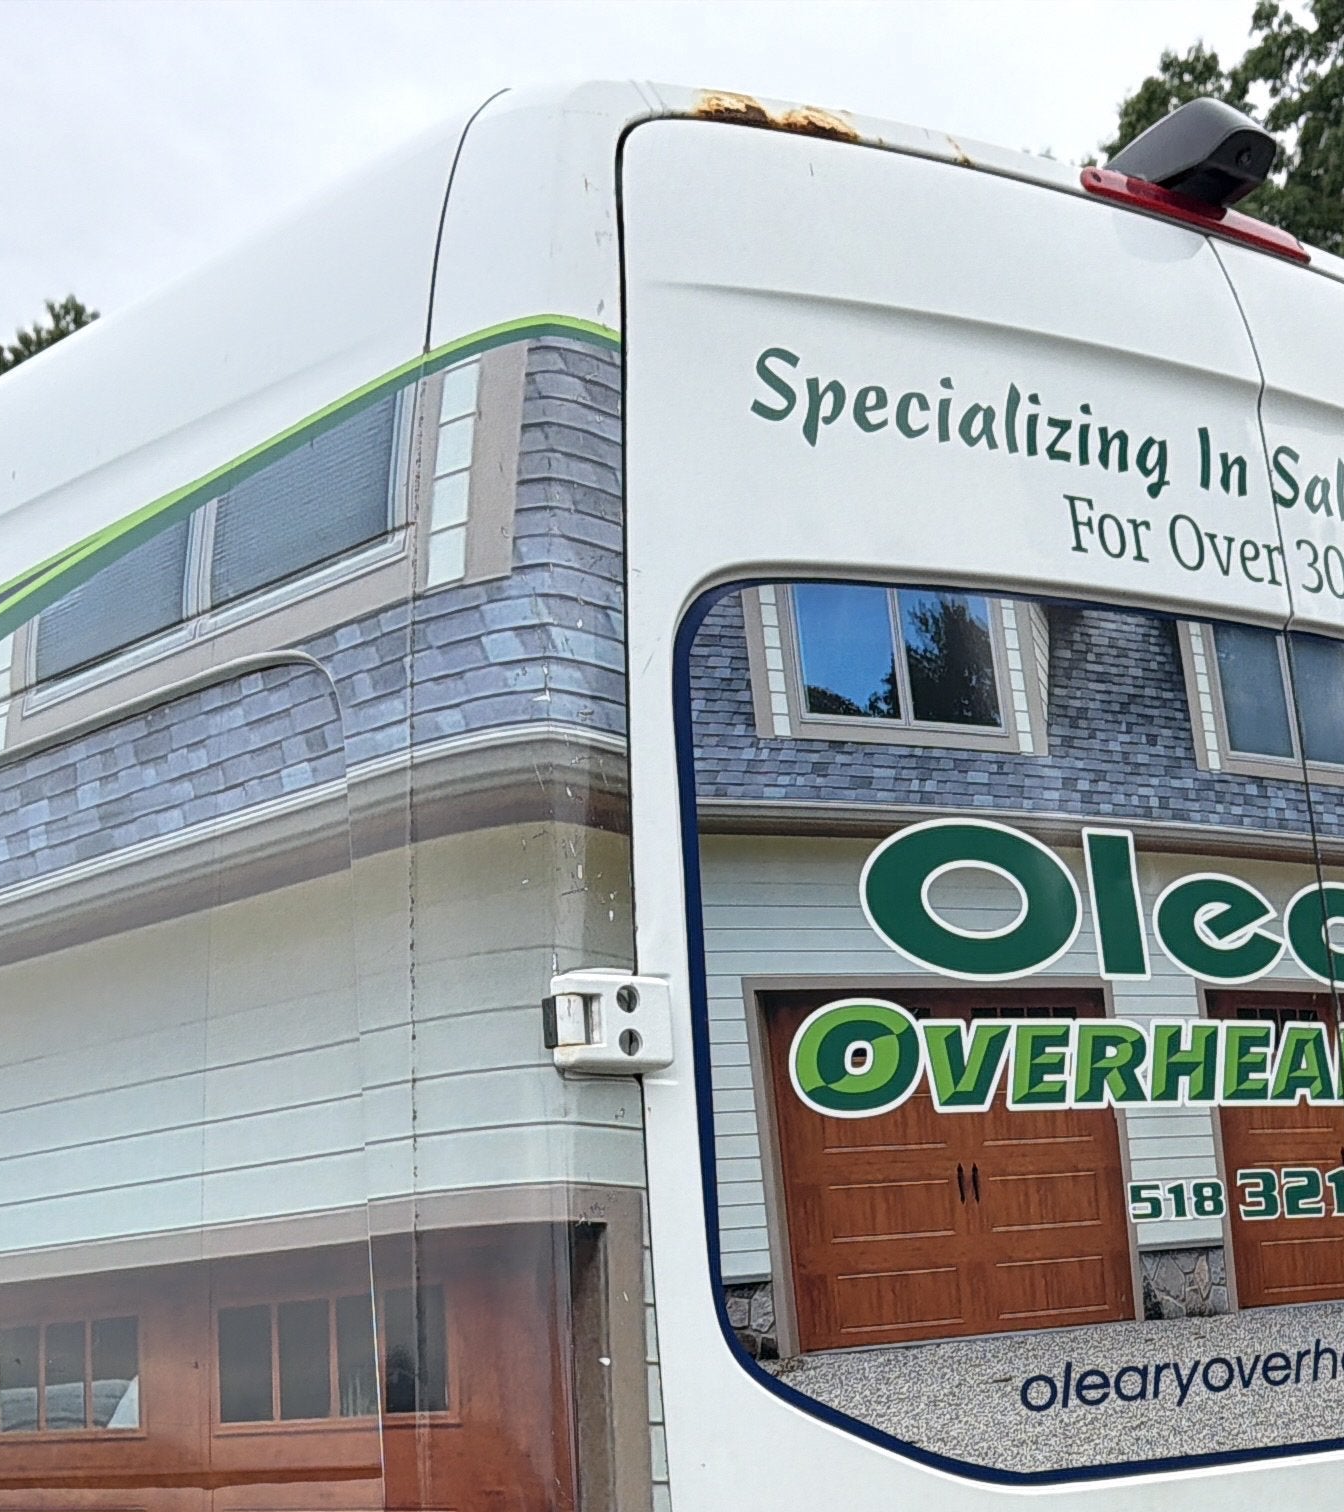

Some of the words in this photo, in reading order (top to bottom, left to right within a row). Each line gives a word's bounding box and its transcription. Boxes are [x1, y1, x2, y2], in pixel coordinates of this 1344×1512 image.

[750, 347, 1170, 498] Specializing
[1198, 426, 1249, 497] In
[1062, 494, 1152, 566] For
[1168, 513, 1286, 587] Over
[1127, 1178, 1227, 1224] 518
